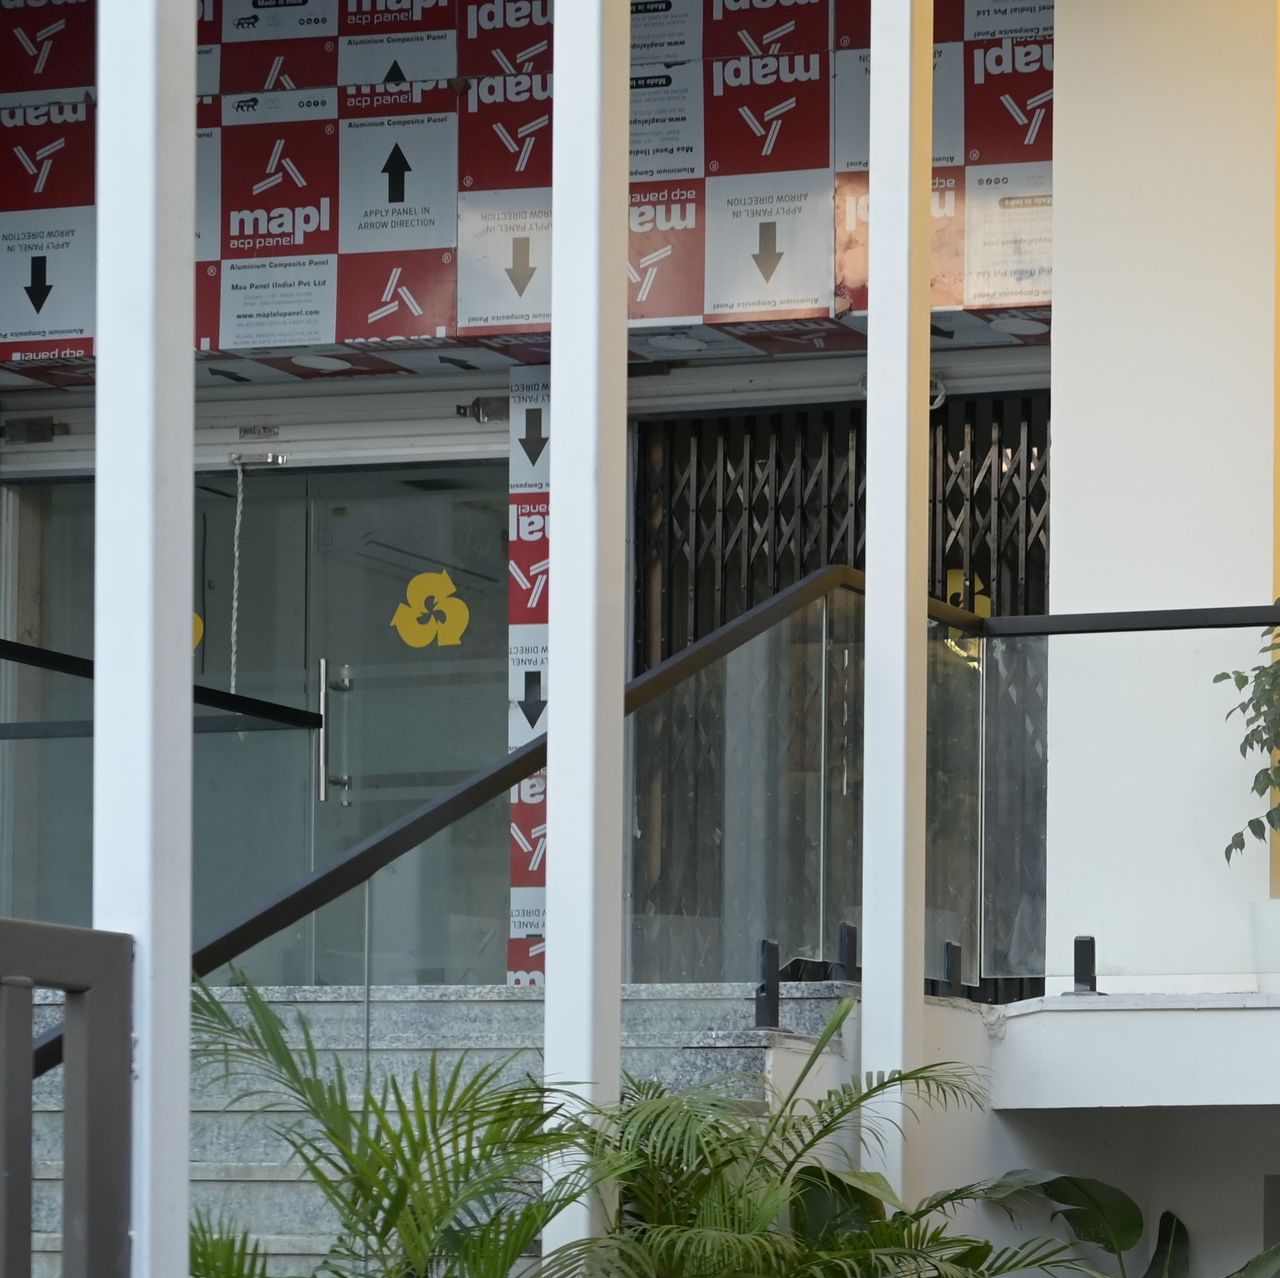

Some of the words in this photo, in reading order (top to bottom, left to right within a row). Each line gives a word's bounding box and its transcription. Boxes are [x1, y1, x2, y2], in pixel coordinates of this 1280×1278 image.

[976, 10, 990, 18] Ltd
[993, 8, 1007, 16] Pvt
[347, 14, 370, 25] acp
[374, 10, 411, 25] panel
[999, 27, 1040, 36] Composite
[347, 38, 384, 46] Aluminium
[387, 35, 424, 44] Composite
[713, 53, 820, 97] mapl
[347, 97, 370, 108] acp
[374, 92, 411, 108] panel
[387, 118, 424, 126] Composite
[427, 115, 448, 124] Panel
[652, 147, 674, 155] Panel
[676, 145, 694, 153] Maa
[846, 160, 869, 168] Panel
[656, 167, 695, 176] Aluminium
[671, 189, 696, 200] acp
[777, 192, 809, 202] ARROW
[727, 196, 774, 207] DIRECTION
[363, 209, 389, 218] APPLY
[391, 207, 419, 217] PANEL
[421, 206, 430, 215] IN
[481, 211, 527, 221] DIRECTION
[732, 210, 742, 219] IN
[745, 208, 773, 217] PANEL
[775, 206, 802, 216] APPLY
[229, 197, 330, 245] mapl
[358, 221, 388, 231] ARROW
[391, 218, 435, 229] DIRECTION
[46, 228, 76, 238] ARROW
[486, 225, 496, 233] IN
[499, 223, 526, 233] PANEL
[1, 231, 45, 242] DIRECTION
[17, 243, 44, 252] PANEL
[46, 241, 71, 251] APPLY
[229, 239, 253, 250] acp
[256, 235, 294, 249] panel
[7, 245, 16, 253] IN
[230, 263, 267, 271] Aluminium
[269, 260, 307, 269] Composite
[231, 283, 247, 291] Maa
[249, 282, 270, 290] Panel
[313, 279, 326, 287] Ltd
[712, 302, 734, 310] Panel
[467, 315, 488, 324] Panel
[511, 395, 538, 404] PANEL
[511, 658, 538, 666] PANEL
[511, 920, 539, 930] PANEL
